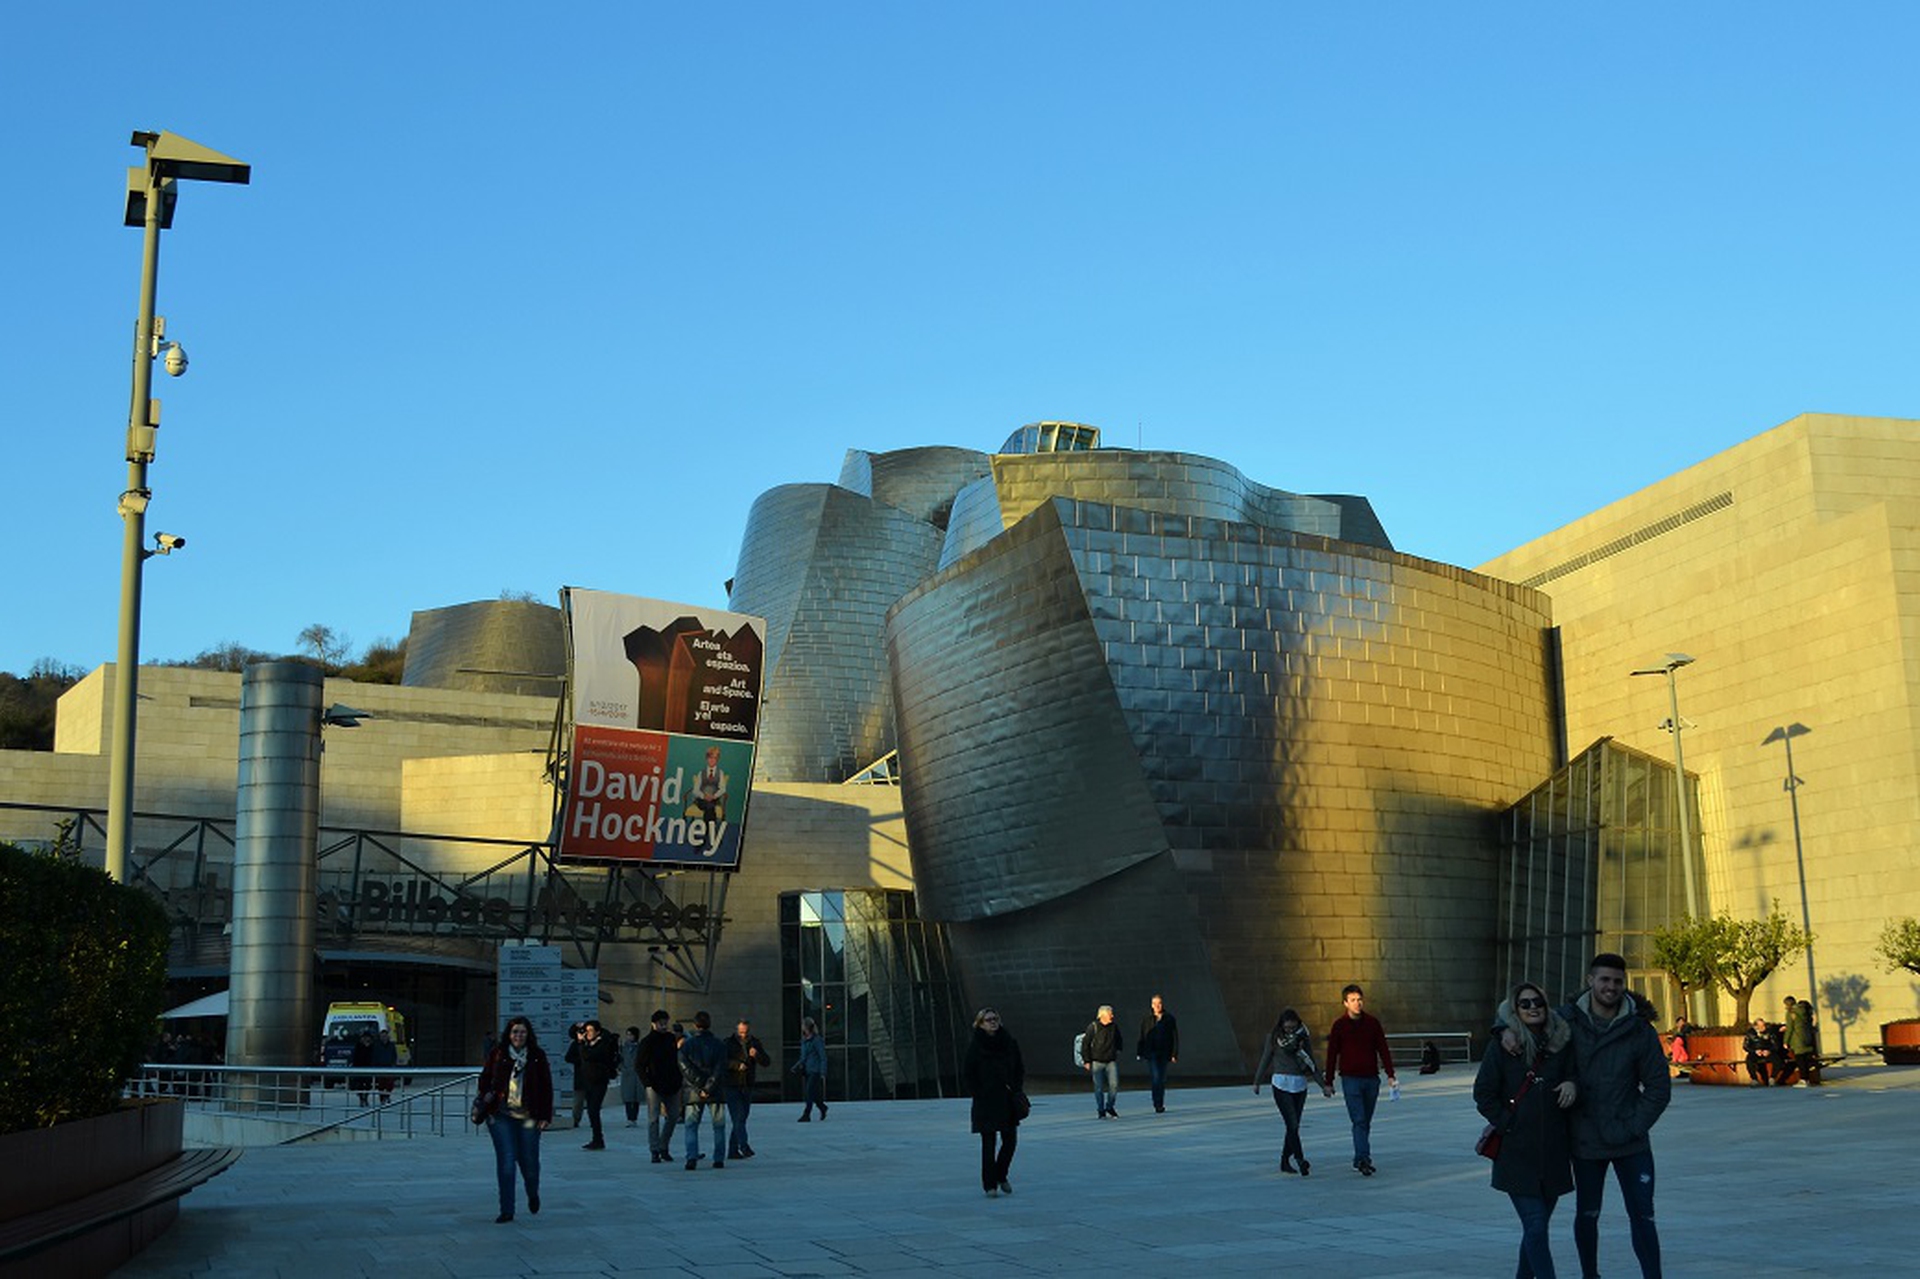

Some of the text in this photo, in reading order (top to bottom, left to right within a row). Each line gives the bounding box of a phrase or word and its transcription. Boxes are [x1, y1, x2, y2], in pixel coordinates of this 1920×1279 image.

[692, 638, 721, 651] Artea
[716, 651, 733, 661] eta
[730, 678, 747, 689] Art
[703, 685, 754, 699] and Space.
[700, 701, 730, 713] El arte
[701, 710, 712, 720] el
[710, 721, 748, 733] espacio.
[578, 760, 684, 805] David
[572, 801, 728, 857] Hockney
[361, 880, 510, 925] Bilbao
[536, 886, 708, 930] Museoa
